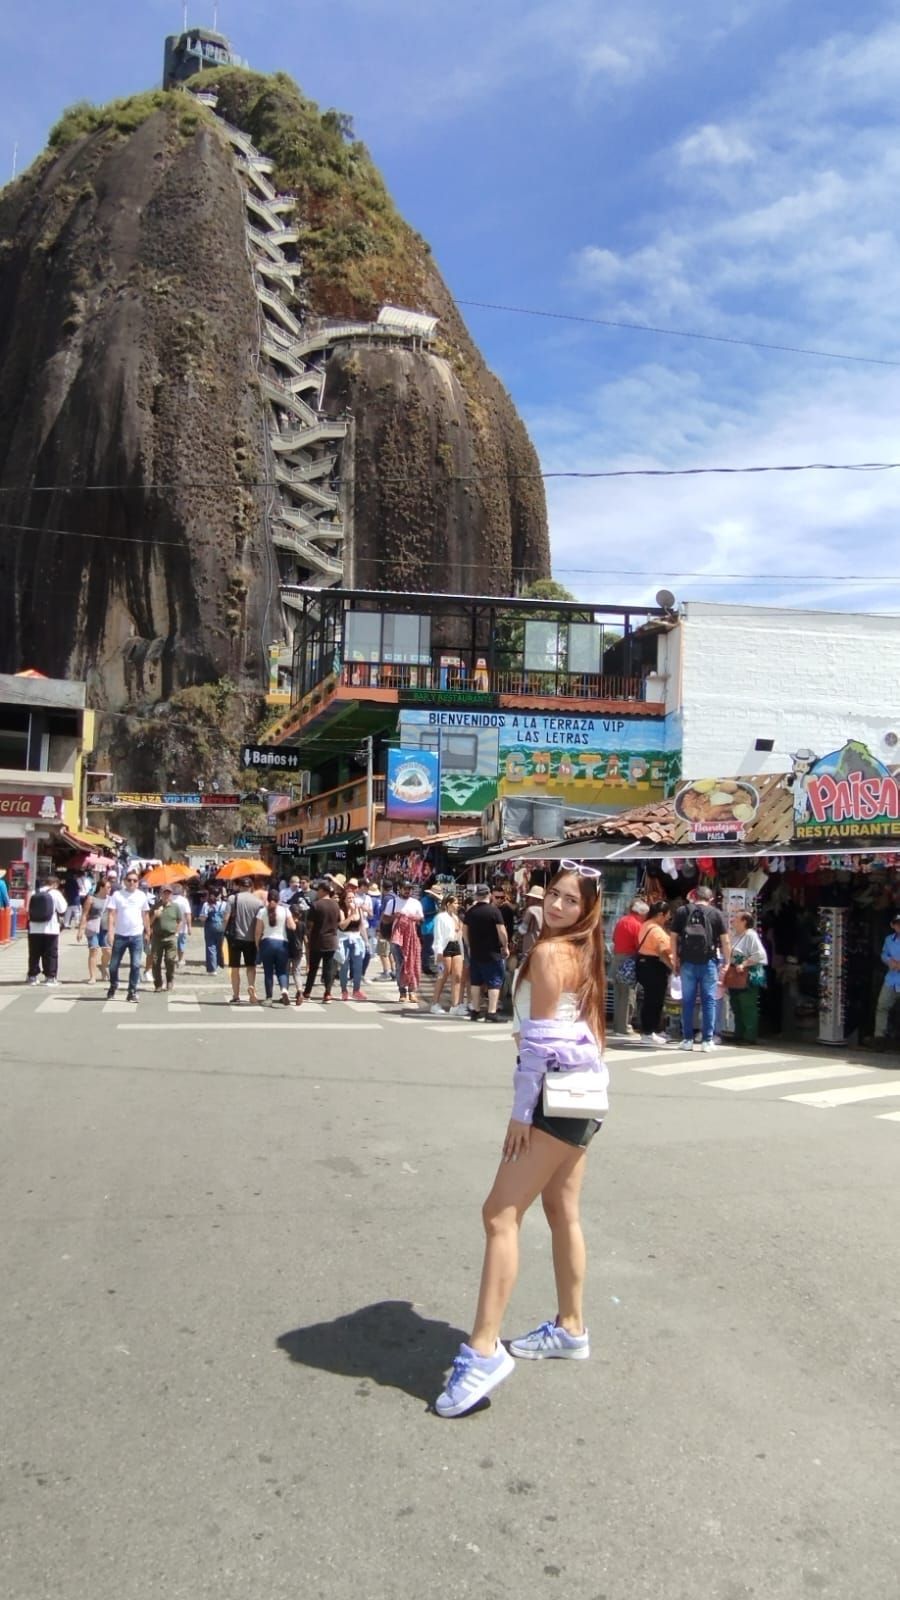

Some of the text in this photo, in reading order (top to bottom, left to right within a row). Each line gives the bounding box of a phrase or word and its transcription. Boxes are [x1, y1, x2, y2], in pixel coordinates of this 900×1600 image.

[429, 712, 625, 732] BIENVENIDOS A LA TERRAZA VIP
[517, 730, 589, 744] LAS LETRAS
[252, 751, 287, 765] Baños
[0, 796, 31, 812] ería
[117, 794, 161, 804] TERRAZA
[796, 822, 900, 838] RESTAURANTE
[335, 850, 347, 858] WC
